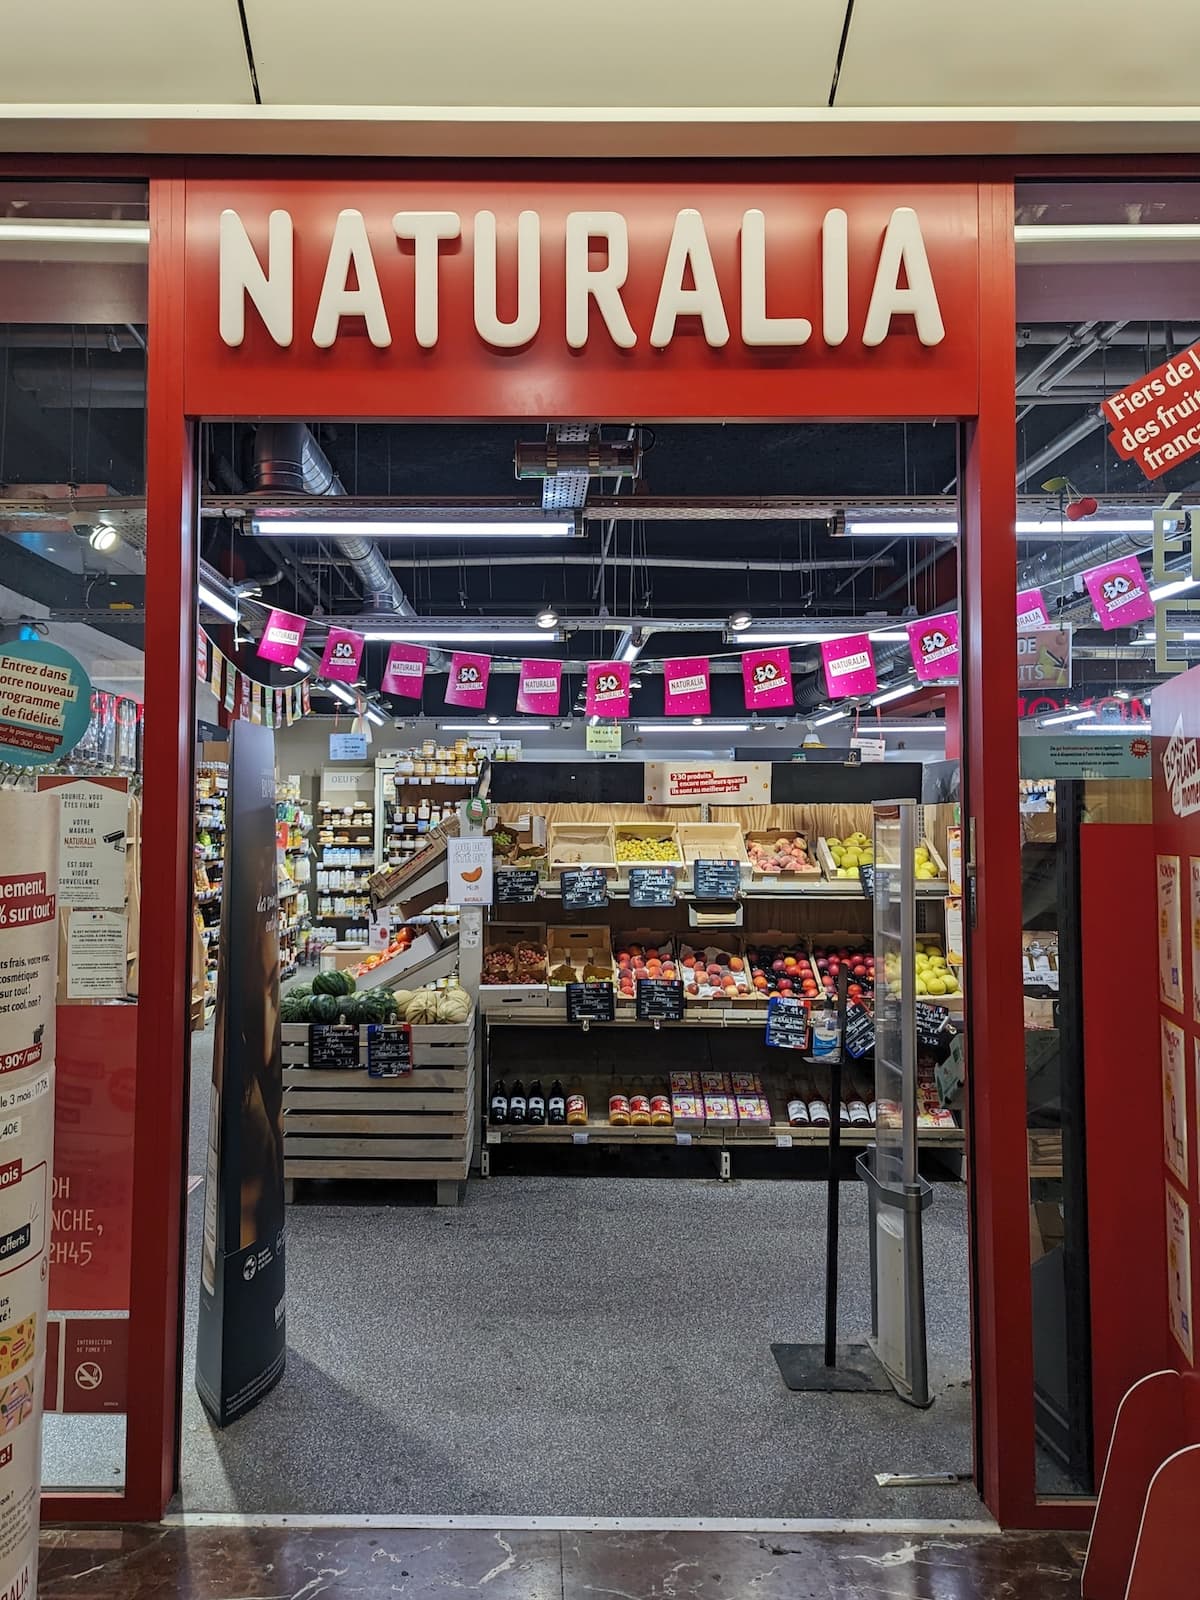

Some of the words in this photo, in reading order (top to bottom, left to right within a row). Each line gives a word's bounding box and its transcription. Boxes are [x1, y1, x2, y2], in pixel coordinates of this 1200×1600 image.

[219, 207, 946, 349] NATURALIA
[1107, 378, 1166, 421] Fiers
[1165, 362, 1194, 388] de
[1121, 419, 1161, 452] des
[1103, 577, 1130, 600] 50
[922, 632, 947, 652] 50
[335, 643, 353, 658] 50
[926, 647, 954, 661] NATURALIA
[1, 657, 38, 675] Entrez
[39, 666, 67, 682] dans
[393, 662, 421, 672] NATURALIA
[832, 657, 867, 671] NATURALIA
[460, 667, 479, 682] 50
[755, 664, 778, 682] 50
[26, 677, 74, 699] nouveau
[525, 679, 555, 689] NATURALIA
[597, 676, 618, 691] 50
[671, 678, 704, 690] NATURALIA
[757, 679, 784, 691] NATURALIA
[598, 690, 622, 700] NATURALIA
[2, 704, 16, 718] de
[17, 707, 61, 728] fidélité.
[331, 775, 360, 784] OEUFS
[687, 771, 712, 780] produits
[61, 793, 86, 801] SOURIEZ,
[89, 793, 103, 801] VOUS
[64, 800, 78, 809] ÊTES
[79, 801, 100, 809] FILMÉS
[64, 836, 97, 846] NATURALIA
[72, 869, 88, 877] VIDÉO
[59, 878, 99, 886] SURVEILLANCE
[9, 906, 31, 922] sur
[10, 1094, 15, 1105] 3
